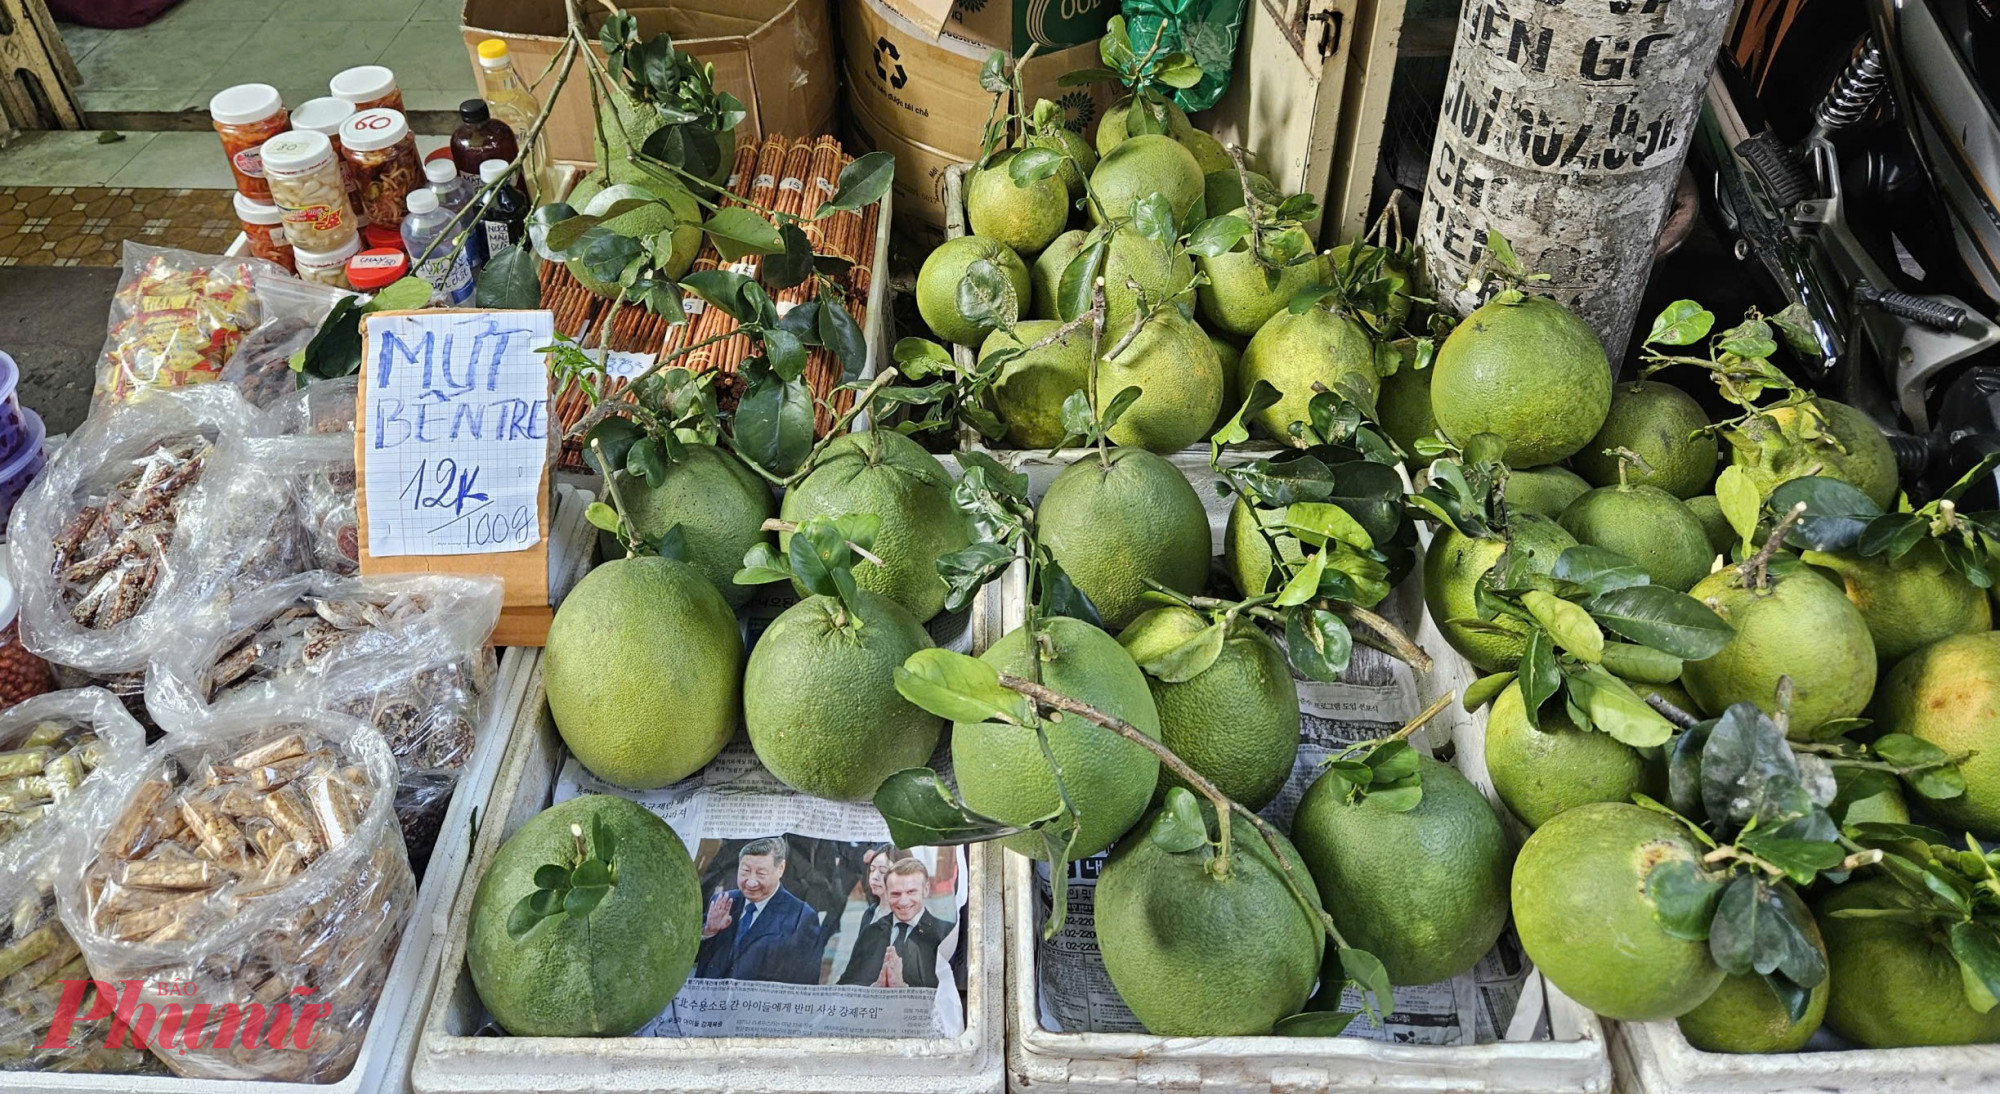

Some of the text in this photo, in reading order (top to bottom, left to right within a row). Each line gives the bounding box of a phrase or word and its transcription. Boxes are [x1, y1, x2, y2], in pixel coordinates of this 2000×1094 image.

[355, 114, 392, 131] 60
[399, 457, 490, 516] 12K
[729, 999, 740, 1011] 간
[742, 1000, 792, 1014] 아이들에게
[794, 1003, 814, 1015] 반미
[816, 1003, 837, 1017] 사상
